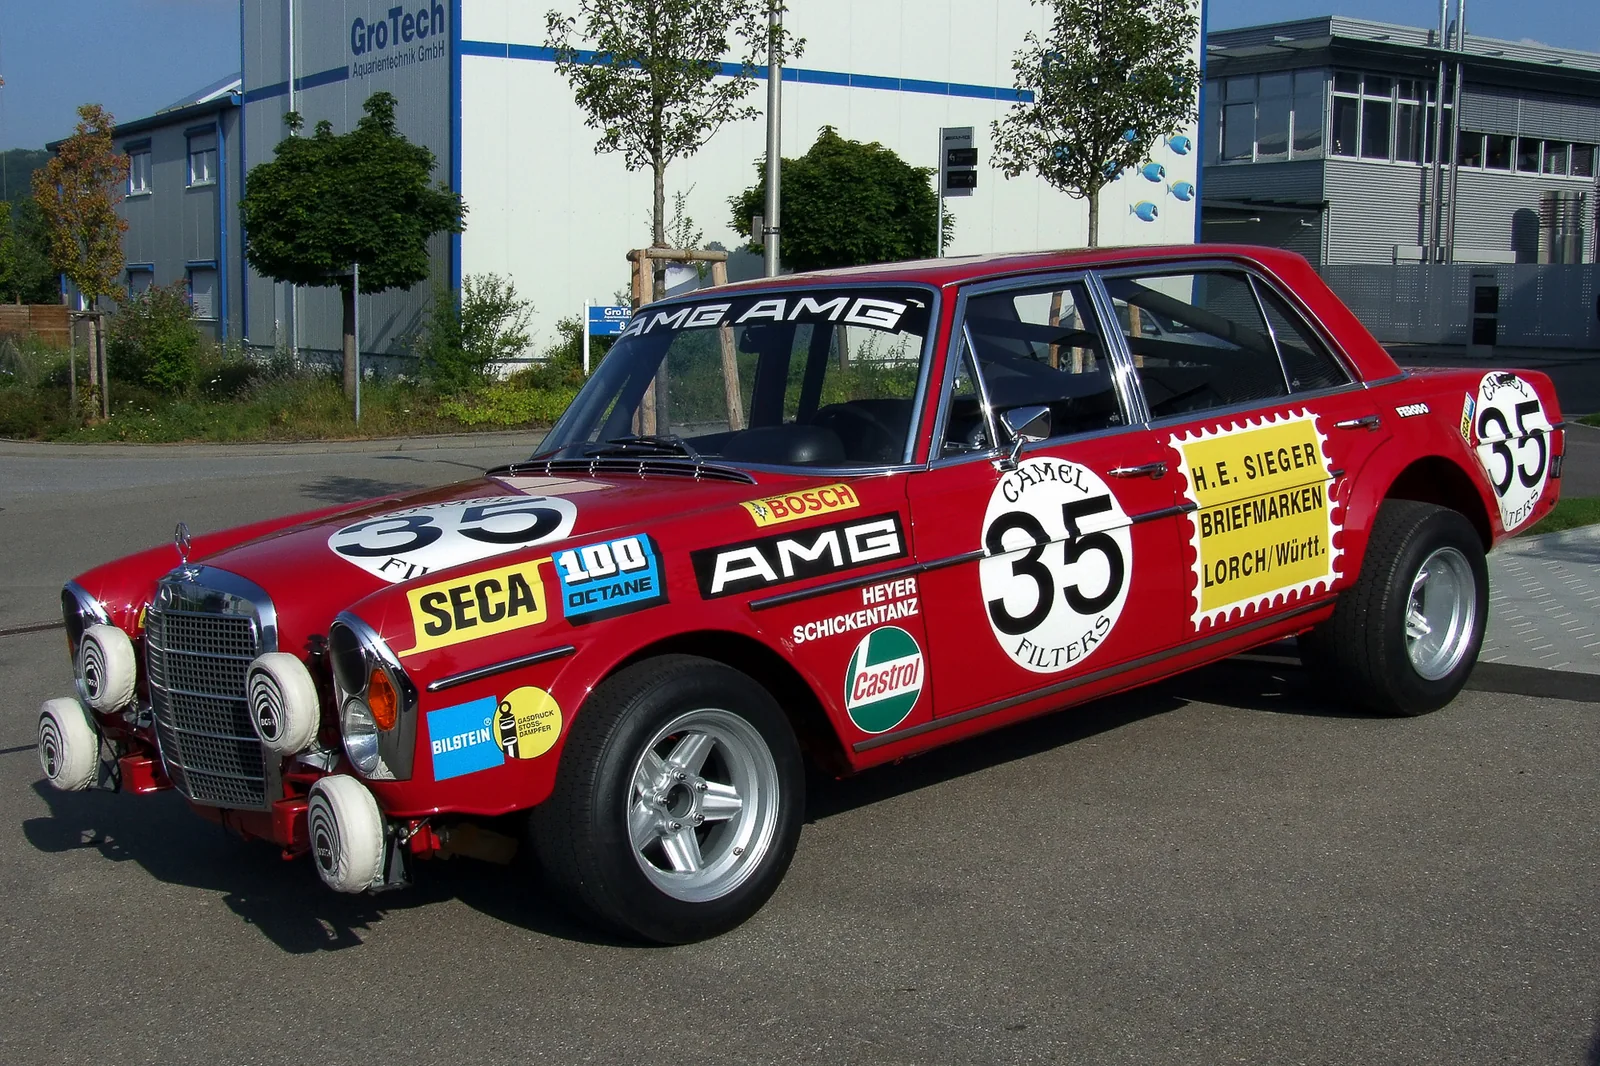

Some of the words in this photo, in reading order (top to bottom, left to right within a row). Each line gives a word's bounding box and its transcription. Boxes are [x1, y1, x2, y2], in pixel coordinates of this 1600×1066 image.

[351, 0, 444, 56] GroTech
[353, 50, 416, 79] Aquarientechnik
[418, 40, 444, 62] GmbH
[621, 304, 731, 337] AMG
[736, 297, 907, 330] AMG
[1395, 403, 1429, 417] FERODO
[1191, 461, 1238, 492] H.E.
[1243, 442, 1317, 479] SIEGER
[1478, 400, 1546, 498] 35
[766, 486, 854, 518] BOSCH
[1003, 462, 1089, 503] CAMEL
[335, 498, 563, 557] 35
[1200, 485, 1323, 538] BRIEFMARKEN
[559, 538, 647, 585] 100
[710, 518, 901, 594] AMG
[985, 493, 1125, 636] 35
[1203, 535, 1325, 588] LORCH/Württ.
[419, 573, 537, 637] SECA
[569, 576, 652, 607] OCTANE
[861, 577, 917, 605] HEYER
[793, 598, 919, 644] SCHICKENTANZ
[1014, 615, 1111, 668] FILTERS
[853, 658, 920, 700] Castrol
[517, 710, 554, 725] GASDRUCK
[518, 721, 542, 732] STOSS-
[432, 727, 490, 755] BILSTEIN
